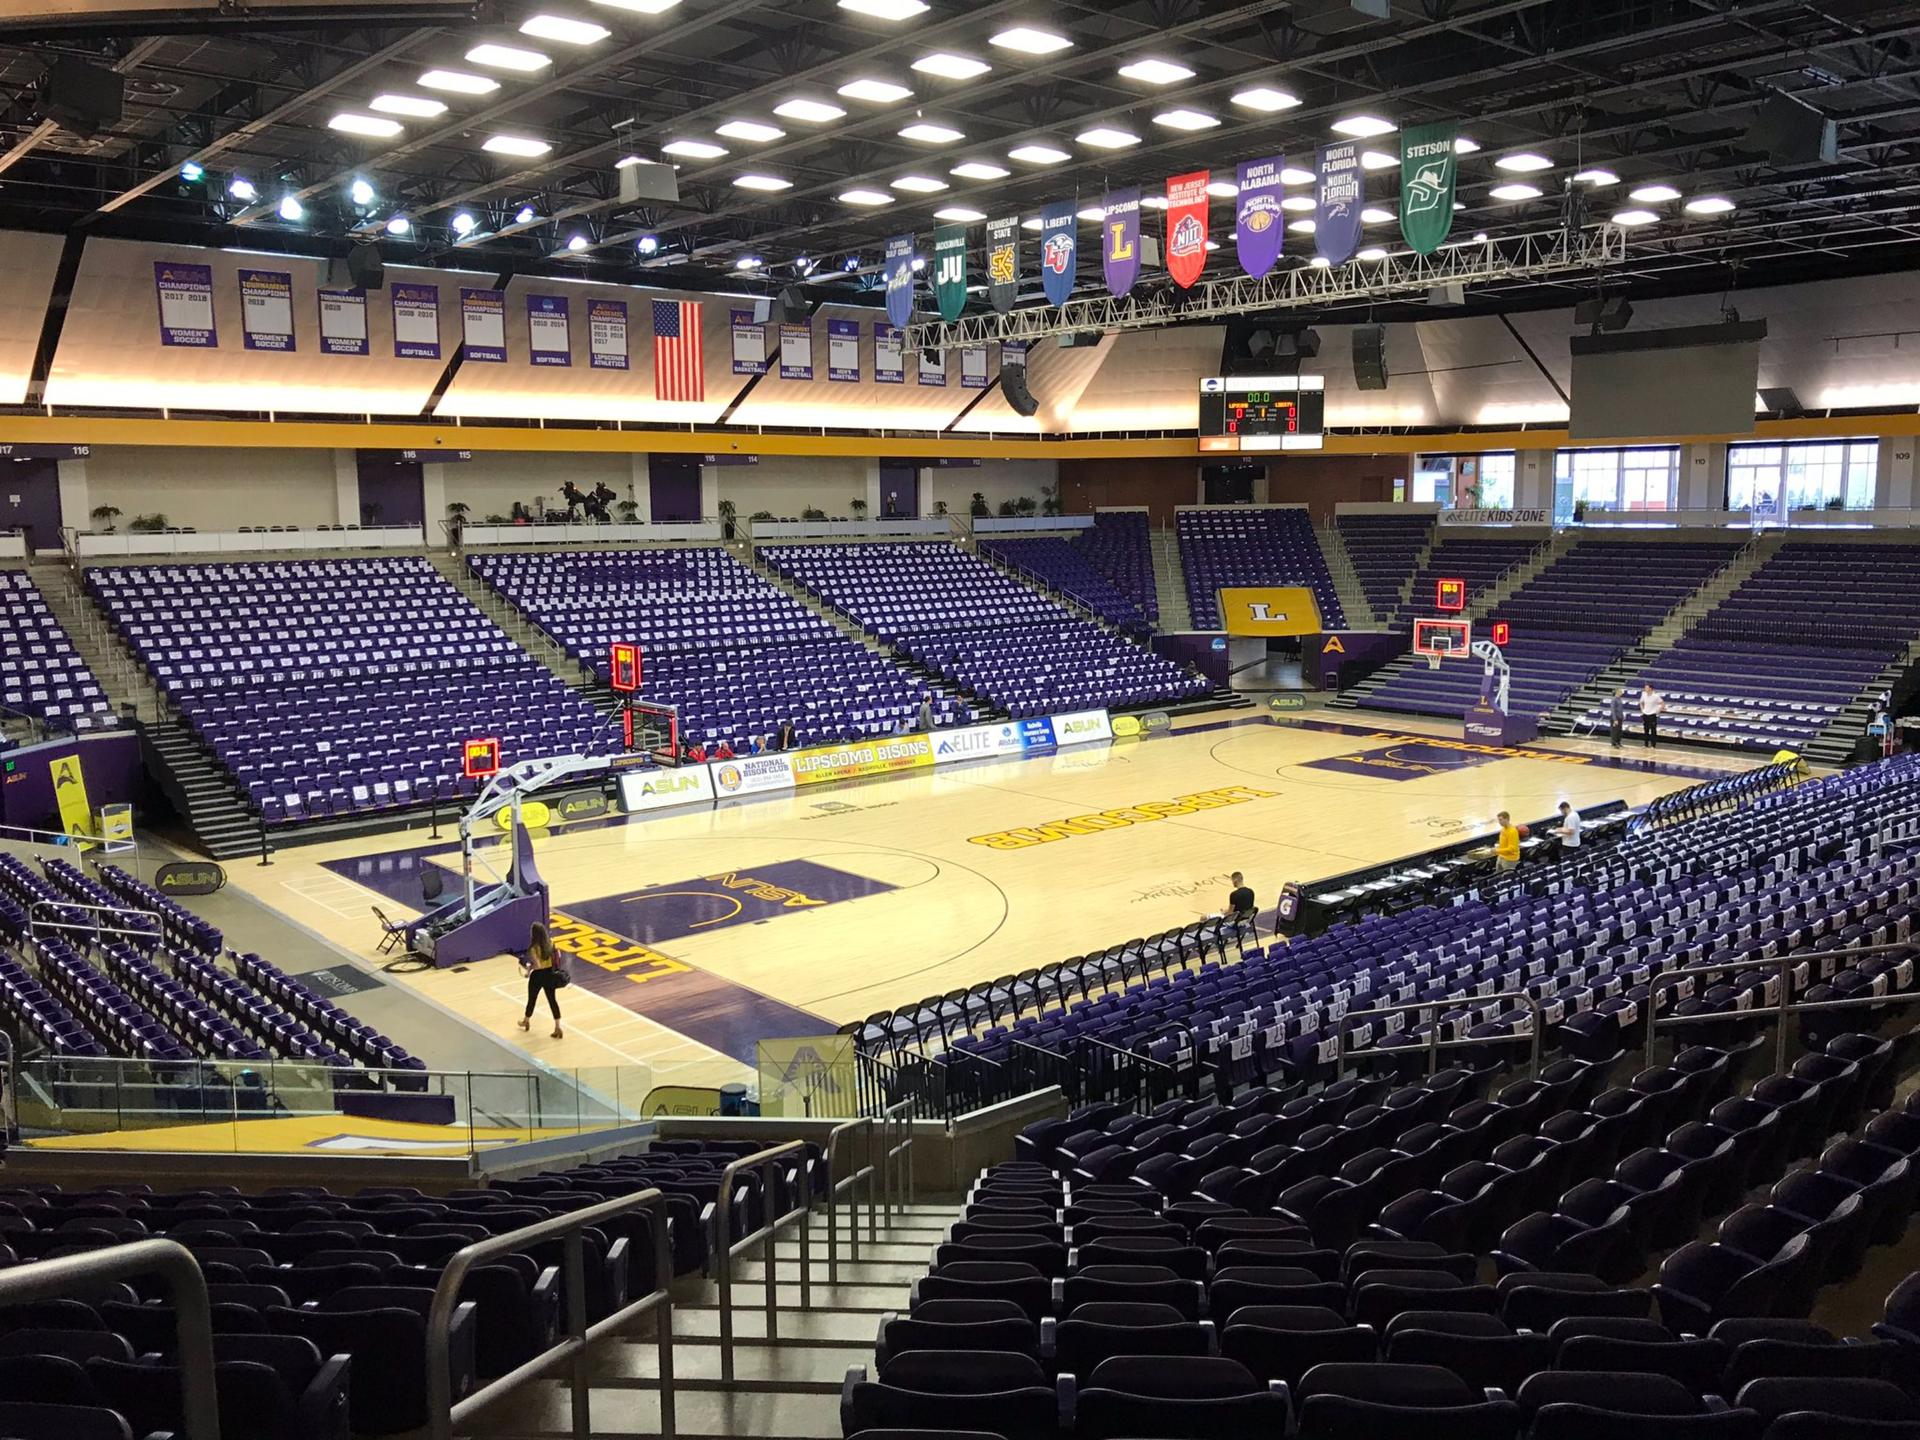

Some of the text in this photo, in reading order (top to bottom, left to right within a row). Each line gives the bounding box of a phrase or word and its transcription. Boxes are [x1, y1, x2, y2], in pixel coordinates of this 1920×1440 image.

[1326, 146, 1354, 161] NORTH
[1407, 140, 1450, 158] STETSON
[1246, 164, 1274, 178] NORTH
[1322, 157, 1357, 173] FLORIDA
[1240, 174, 1280, 191] ALABAMA
[1327, 173, 1352, 186] NORTH
[1321, 181, 1358, 202] FLORIDA
[1104, 200, 1139, 216] LIPSCOMB
[1245, 195, 1275, 208] NORTH
[986, 216, 1018, 231] KENNESAW
[1045, 215, 1072, 229] LIBERTY
[994, 228, 1012, 240] STATE
[1178, 227, 1199, 246] NJIT
[1110, 220, 1134, 263] L
[938, 255, 962, 285] JU
[159, 282, 210, 291] CHAMPIONS
[242, 281, 288, 290] TOURNAMENT
[164, 292, 184, 300] 2017
[242, 288, 290, 297] CHAMPIONS
[320, 294, 364, 302] TOURNAMENT
[394, 300, 436, 309] CHAMPIONS
[170, 330, 209, 338] WOMEN'S
[251, 334, 288, 342] WOMEN'S
[402, 348, 434, 356] SOFTBALL
[470, 352, 502, 360] SOFTBALL
[1236, 408, 1242, 418] 0
[1262, 408, 1266, 418] 1
[1288, 408, 1296, 418] 0
[1230, 421, 1236, 432] 0
[1288, 421, 1296, 432] 0
[72, 446, 90, 455] 116
[458, 451, 472, 459] 115
[1515, 510, 1546, 522] ZONE
[1248, 604, 1288, 620] L
[1480, 696, 1488, 705] L
[1064, 718, 1100, 734] ASUN
[954, 732, 990, 752] ELITE
[1362, 733, 1593, 764] LIPSCOMB
[796, 741, 929, 772] LIPSCOMB BISONS
[743, 768, 768, 777] BISON
[768, 764, 790, 774] CLUB
[744, 758, 785, 770] NATIONAL
[726, 772, 736, 785] L
[642, 775, 700, 796] ASUN
[566, 798, 605, 814] ASUN
[966, 785, 1284, 850] LIPSCOMB
[162, 872, 217, 886] ASUN
[1280, 898, 1293, 915] G
